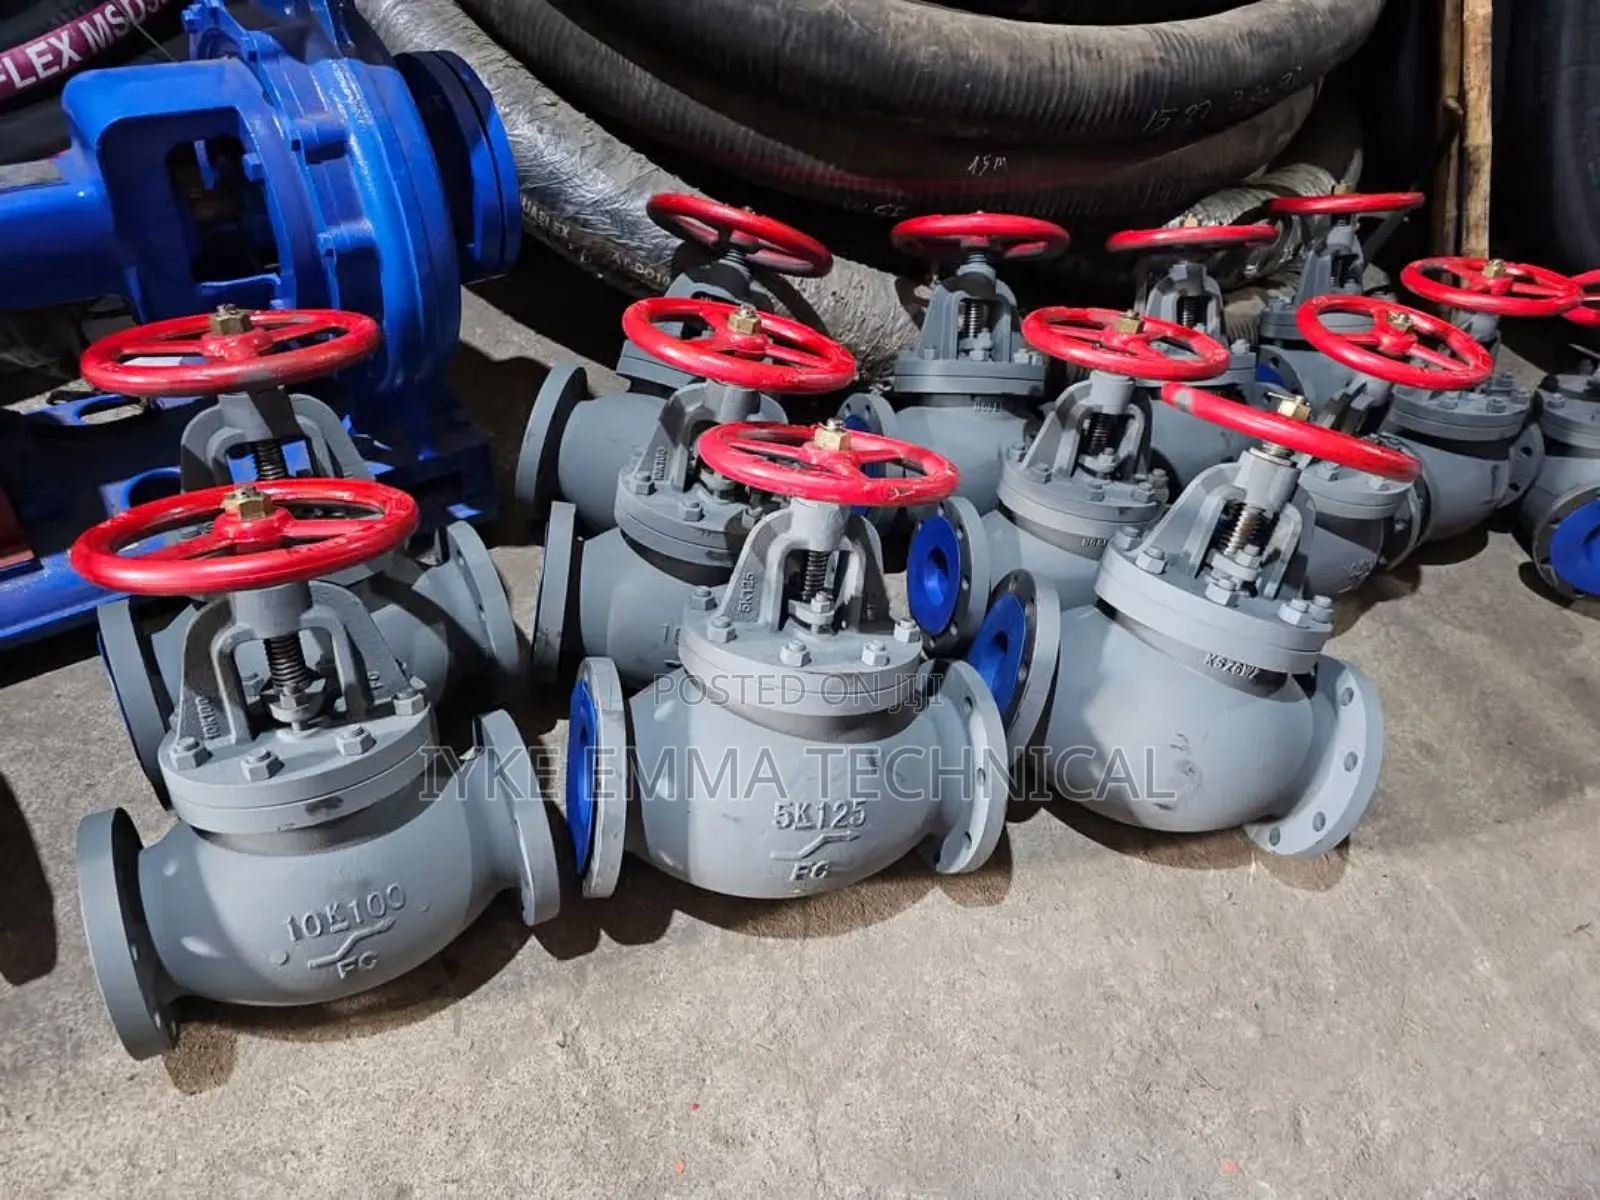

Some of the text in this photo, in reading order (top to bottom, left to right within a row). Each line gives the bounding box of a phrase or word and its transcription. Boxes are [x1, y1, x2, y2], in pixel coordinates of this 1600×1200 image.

[0, 31, 82, 90] LEX
[772, 798, 867, 830] 5K125
[789, 860, 831, 881] FC
[284, 882, 407, 943] 10K100
[337, 950, 379, 980] FC
